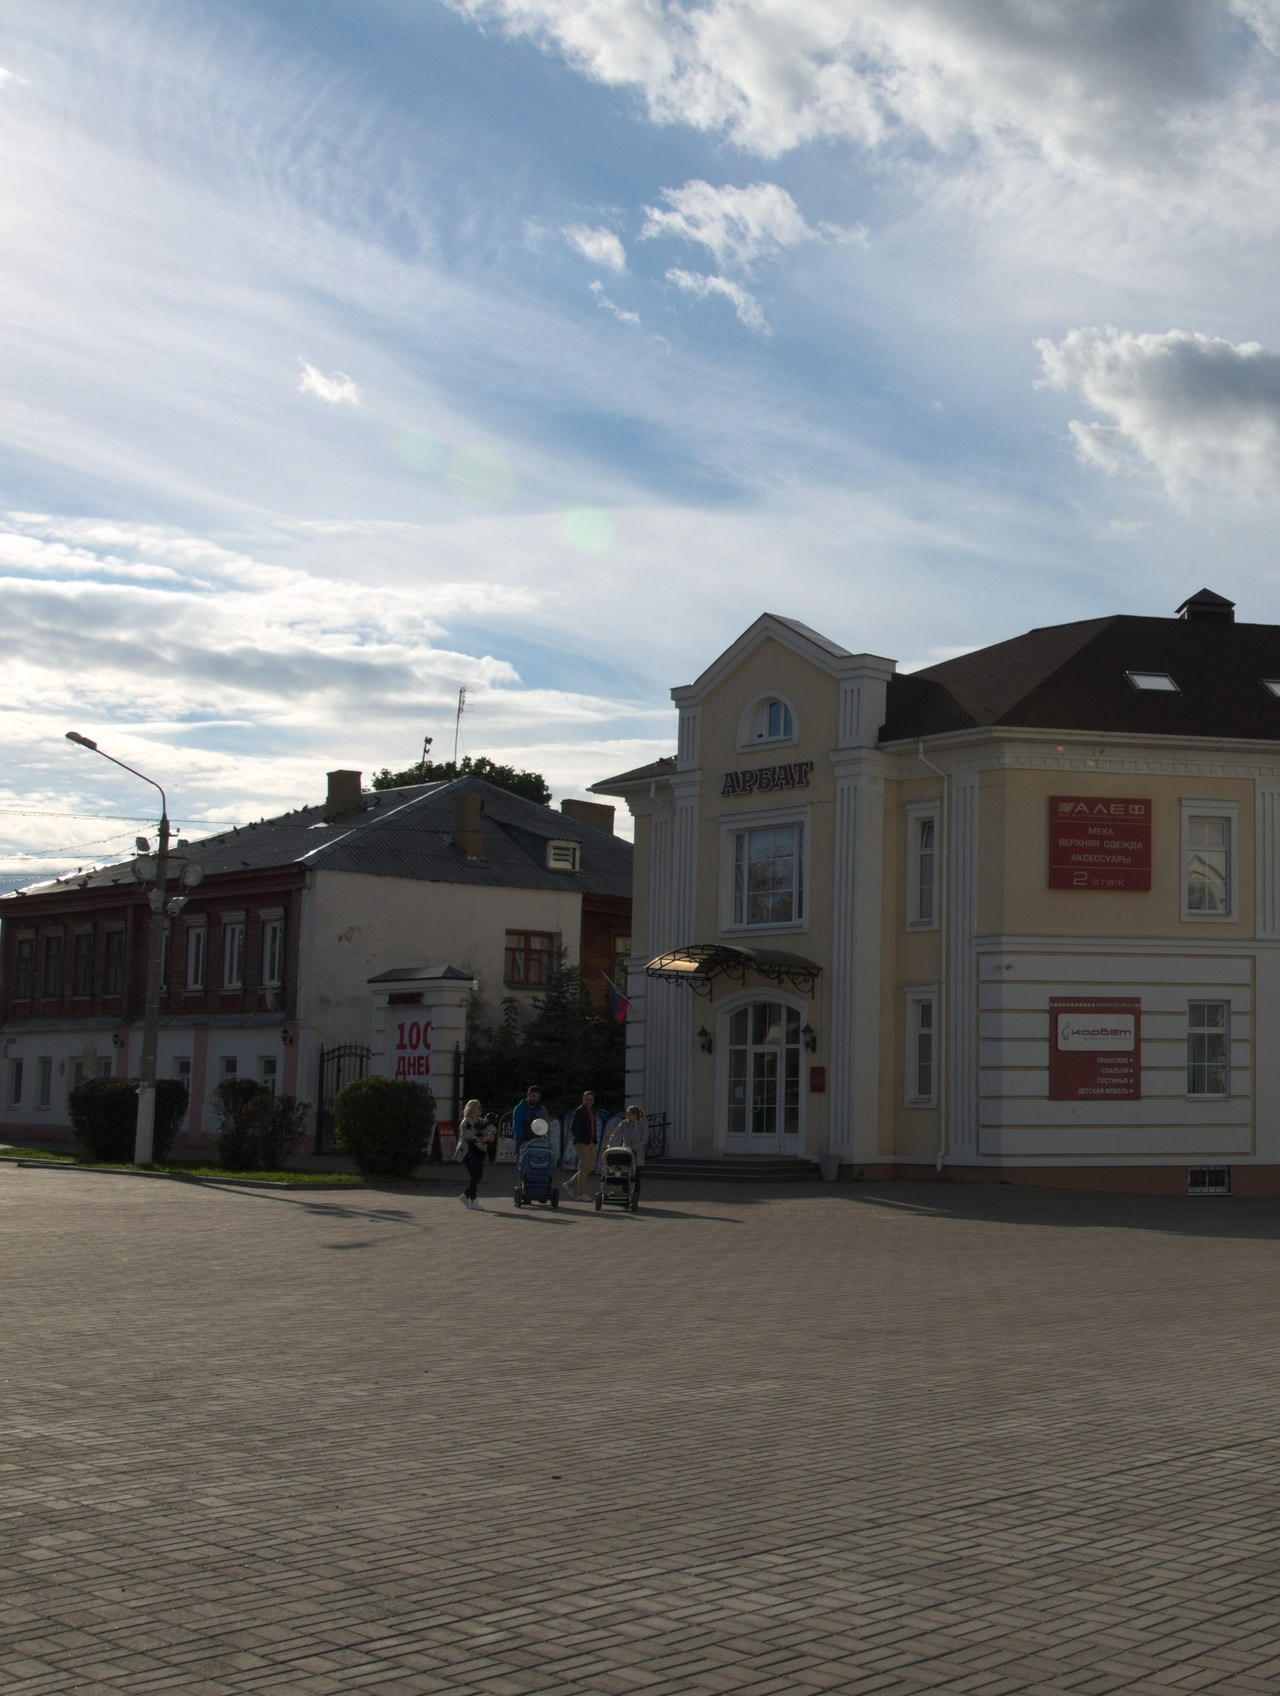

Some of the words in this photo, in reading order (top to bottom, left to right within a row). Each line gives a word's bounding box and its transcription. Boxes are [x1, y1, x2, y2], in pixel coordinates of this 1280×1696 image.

[720, 762, 812, 796] АРБАТ
[1074, 802, 1145, 815] АЛЕФ
[1088, 827, 1114, 836] МЕХА
[1058, 838, 1100, 848] ВЕРХНЯЯ
[1103, 840, 1143, 850] ОДЕЖДА
[1071, 853, 1132, 864] АКСЕССУАРЫ
[1073, 871, 1088, 886] 2
